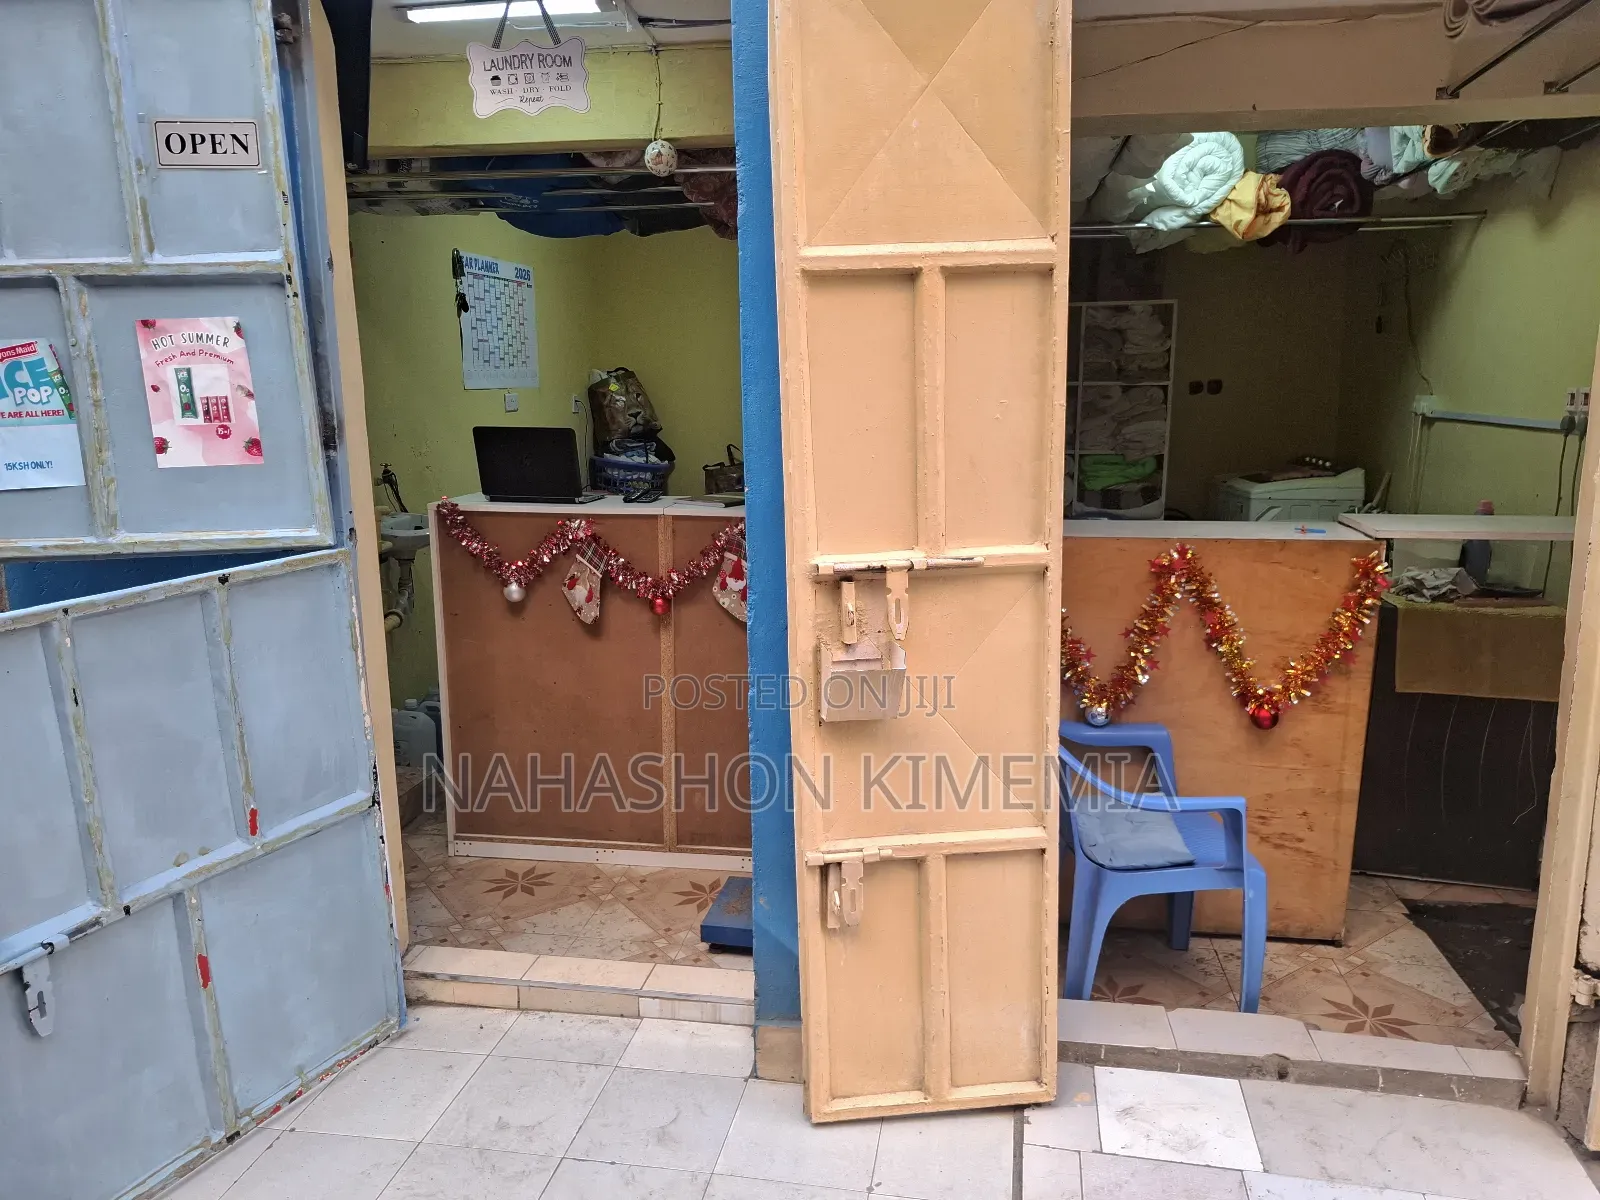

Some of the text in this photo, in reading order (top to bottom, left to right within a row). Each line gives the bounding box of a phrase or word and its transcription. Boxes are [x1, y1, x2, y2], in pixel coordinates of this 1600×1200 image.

[483, 52, 573, 72] LAUNDRY ROOM
[519, 95, 545, 106] Repeat
[164, 132, 250, 155] OPEN
[15, 343, 35, 355] Maid
[151, 332, 230, 351] HOT SUMMER
[154, 348, 235, 368] Fresh And Premium
[13, 386, 53, 406] POP
[0, 409, 65, 419] E ARE ALL HERE!
[30, 460, 54, 470] ONLY!
